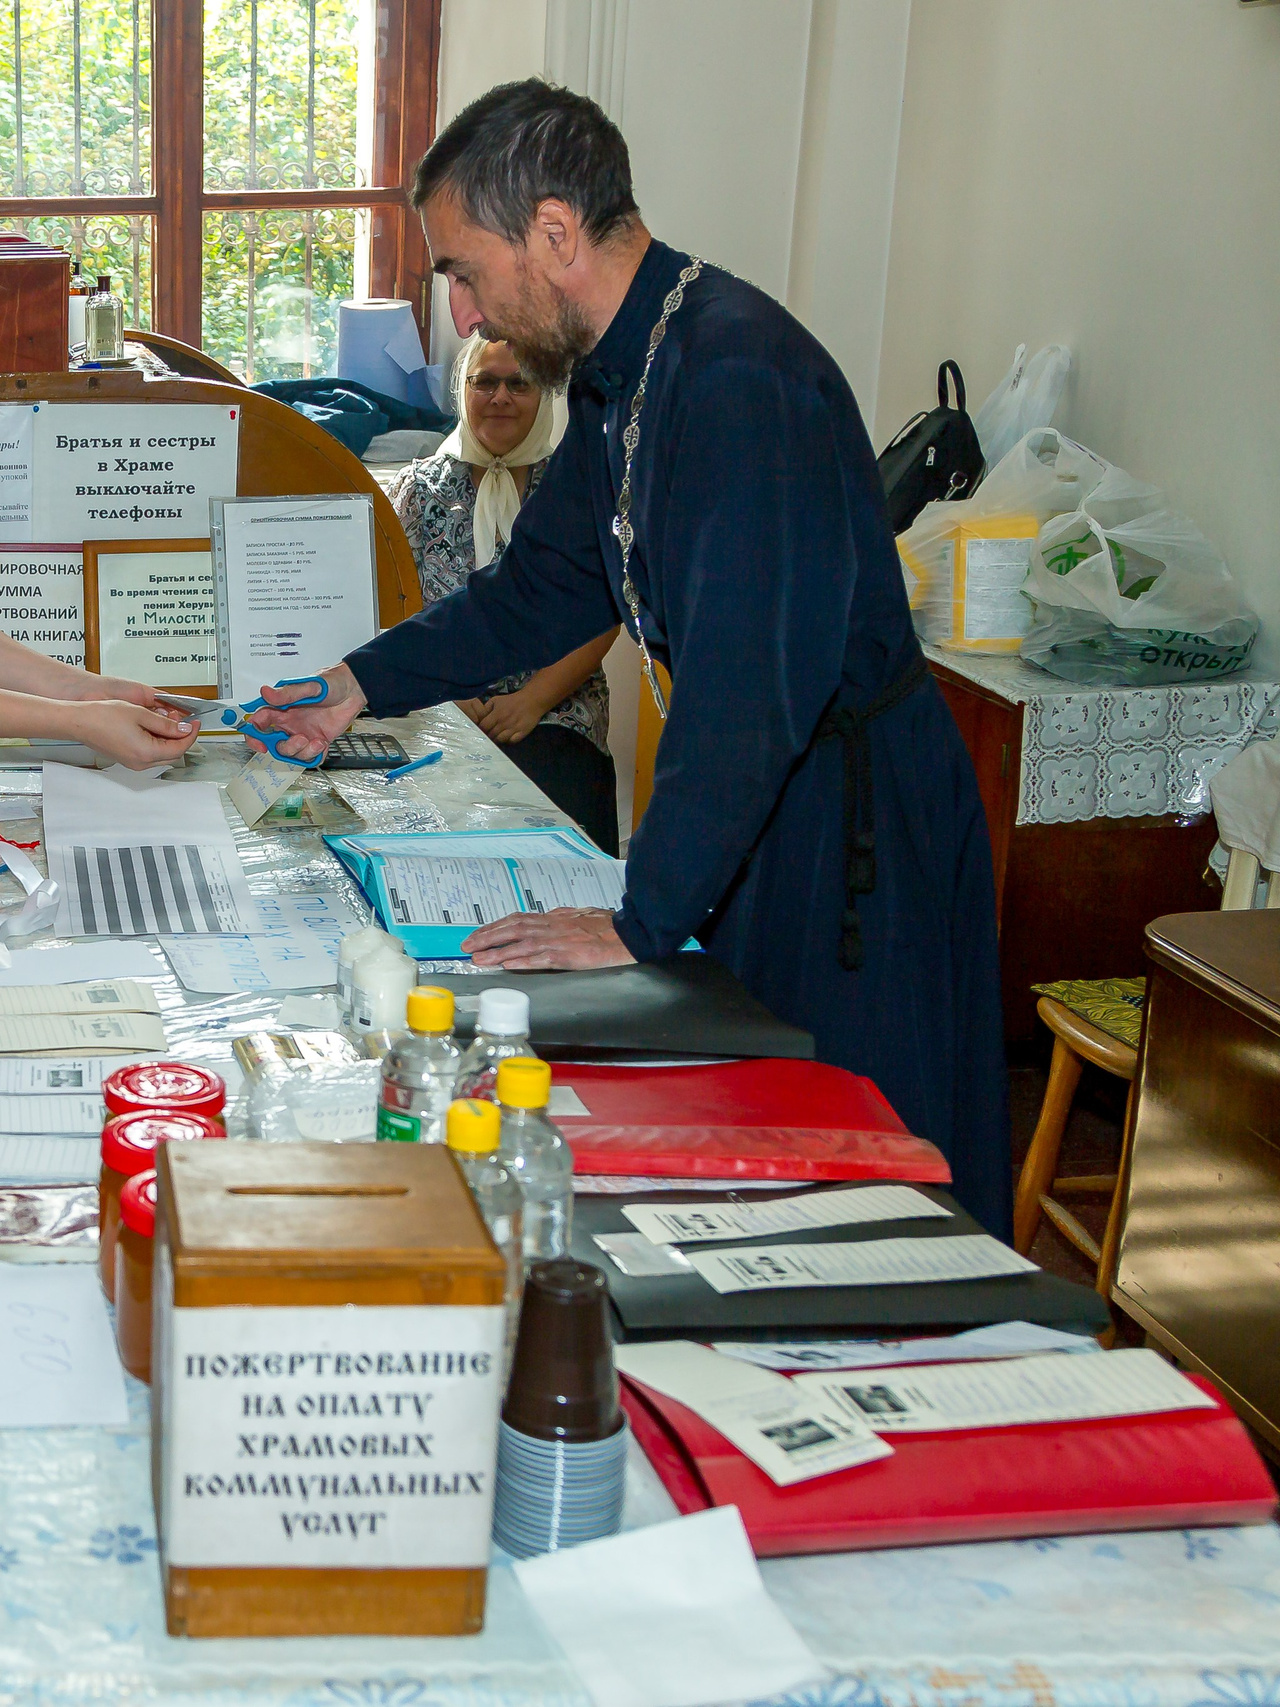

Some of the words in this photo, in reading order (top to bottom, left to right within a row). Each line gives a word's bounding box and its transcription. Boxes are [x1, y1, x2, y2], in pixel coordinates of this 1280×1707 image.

[56, 435, 123, 452] Братья
[129, 437, 141, 448] и
[147, 436, 216, 451] сестры
[97, 462, 108, 472] в
[113, 458, 174, 475] Храме
[0, 473, 28, 483] упокой
[75, 480, 196, 496] выключайте
[87, 505, 183, 522] телефоны
[149, 574, 185, 584] Братья
[110, 589, 124, 597] Во
[127, 589, 159, 598] время
[162, 588, 199, 596] чтения
[143, 602, 175, 610] пения
[11, 630, 30, 642] НА
[33, 630, 86, 642] КНИГАХ
[124, 627, 170, 638] Свечной
[172, 628, 200, 638] ящик
[154, 654, 187, 663] Спаси
[185, 1351, 493, 1379] ПОЖЕРТВОВАНИЕ
[242, 1393, 286, 1418] НА
[296, 1392, 435, 1424] ОПЛАТУ
[236, 1432, 435, 1459] ХРАМОВЫХ
[183, 1471, 487, 1504] КОММУНАЛЬНЫХ
[280, 1510, 388, 1541] УСЛУГ
